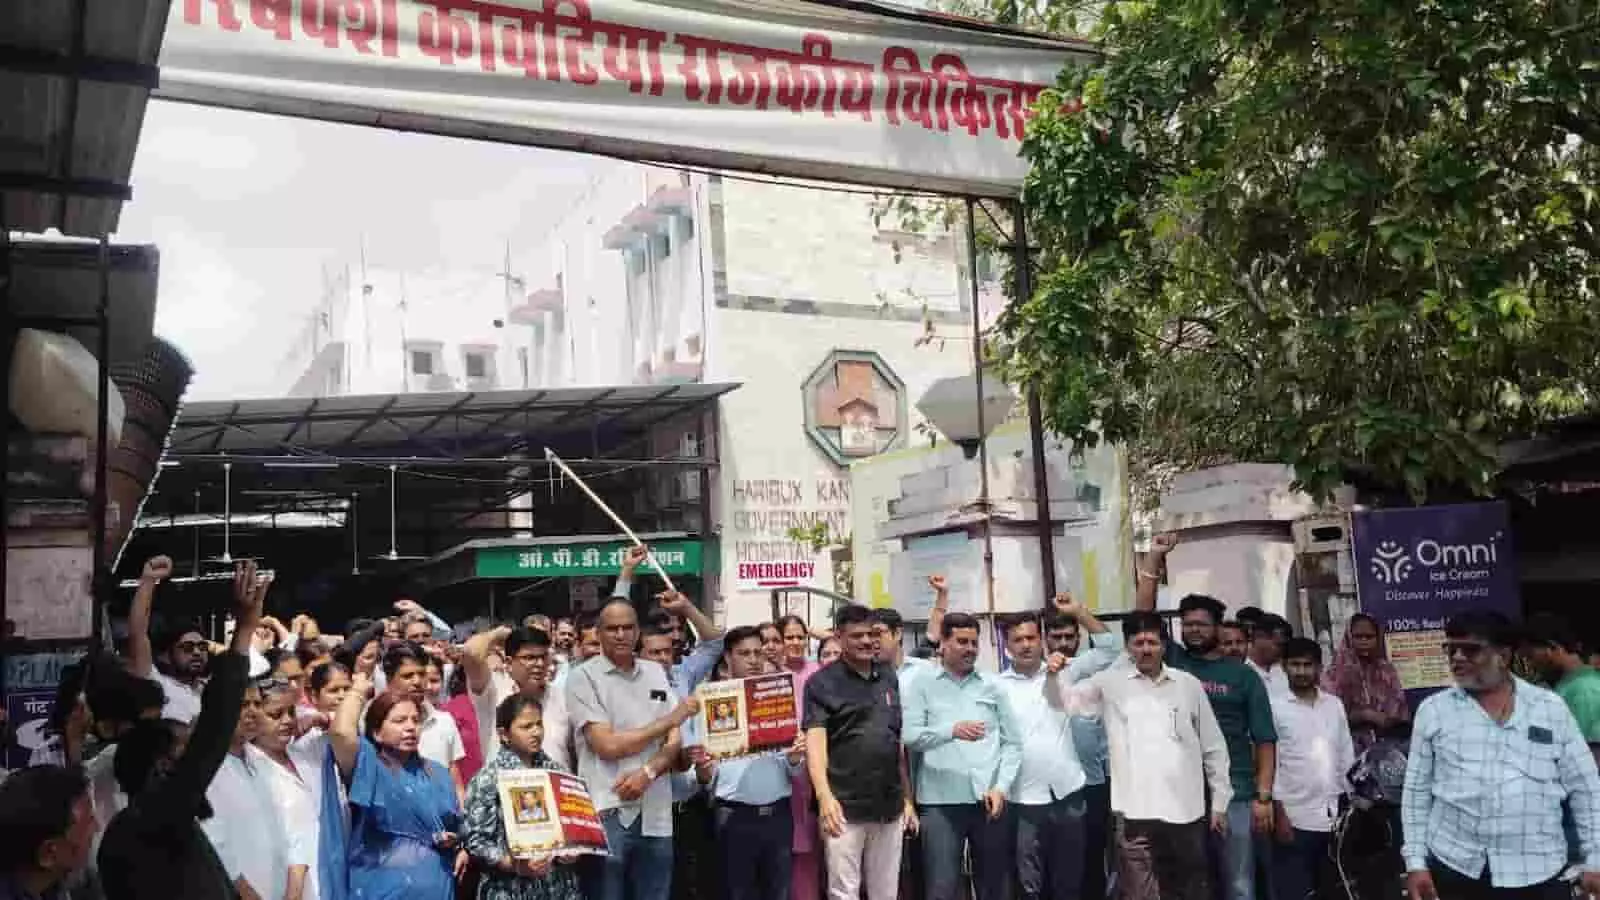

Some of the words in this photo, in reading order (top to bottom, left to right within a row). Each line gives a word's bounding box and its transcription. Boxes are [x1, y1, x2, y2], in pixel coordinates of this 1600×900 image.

[674, 33, 876, 120] राजकीय
[1416, 536, 1497, 566] Omni
[738, 562, 815, 579] EMERGENCY
